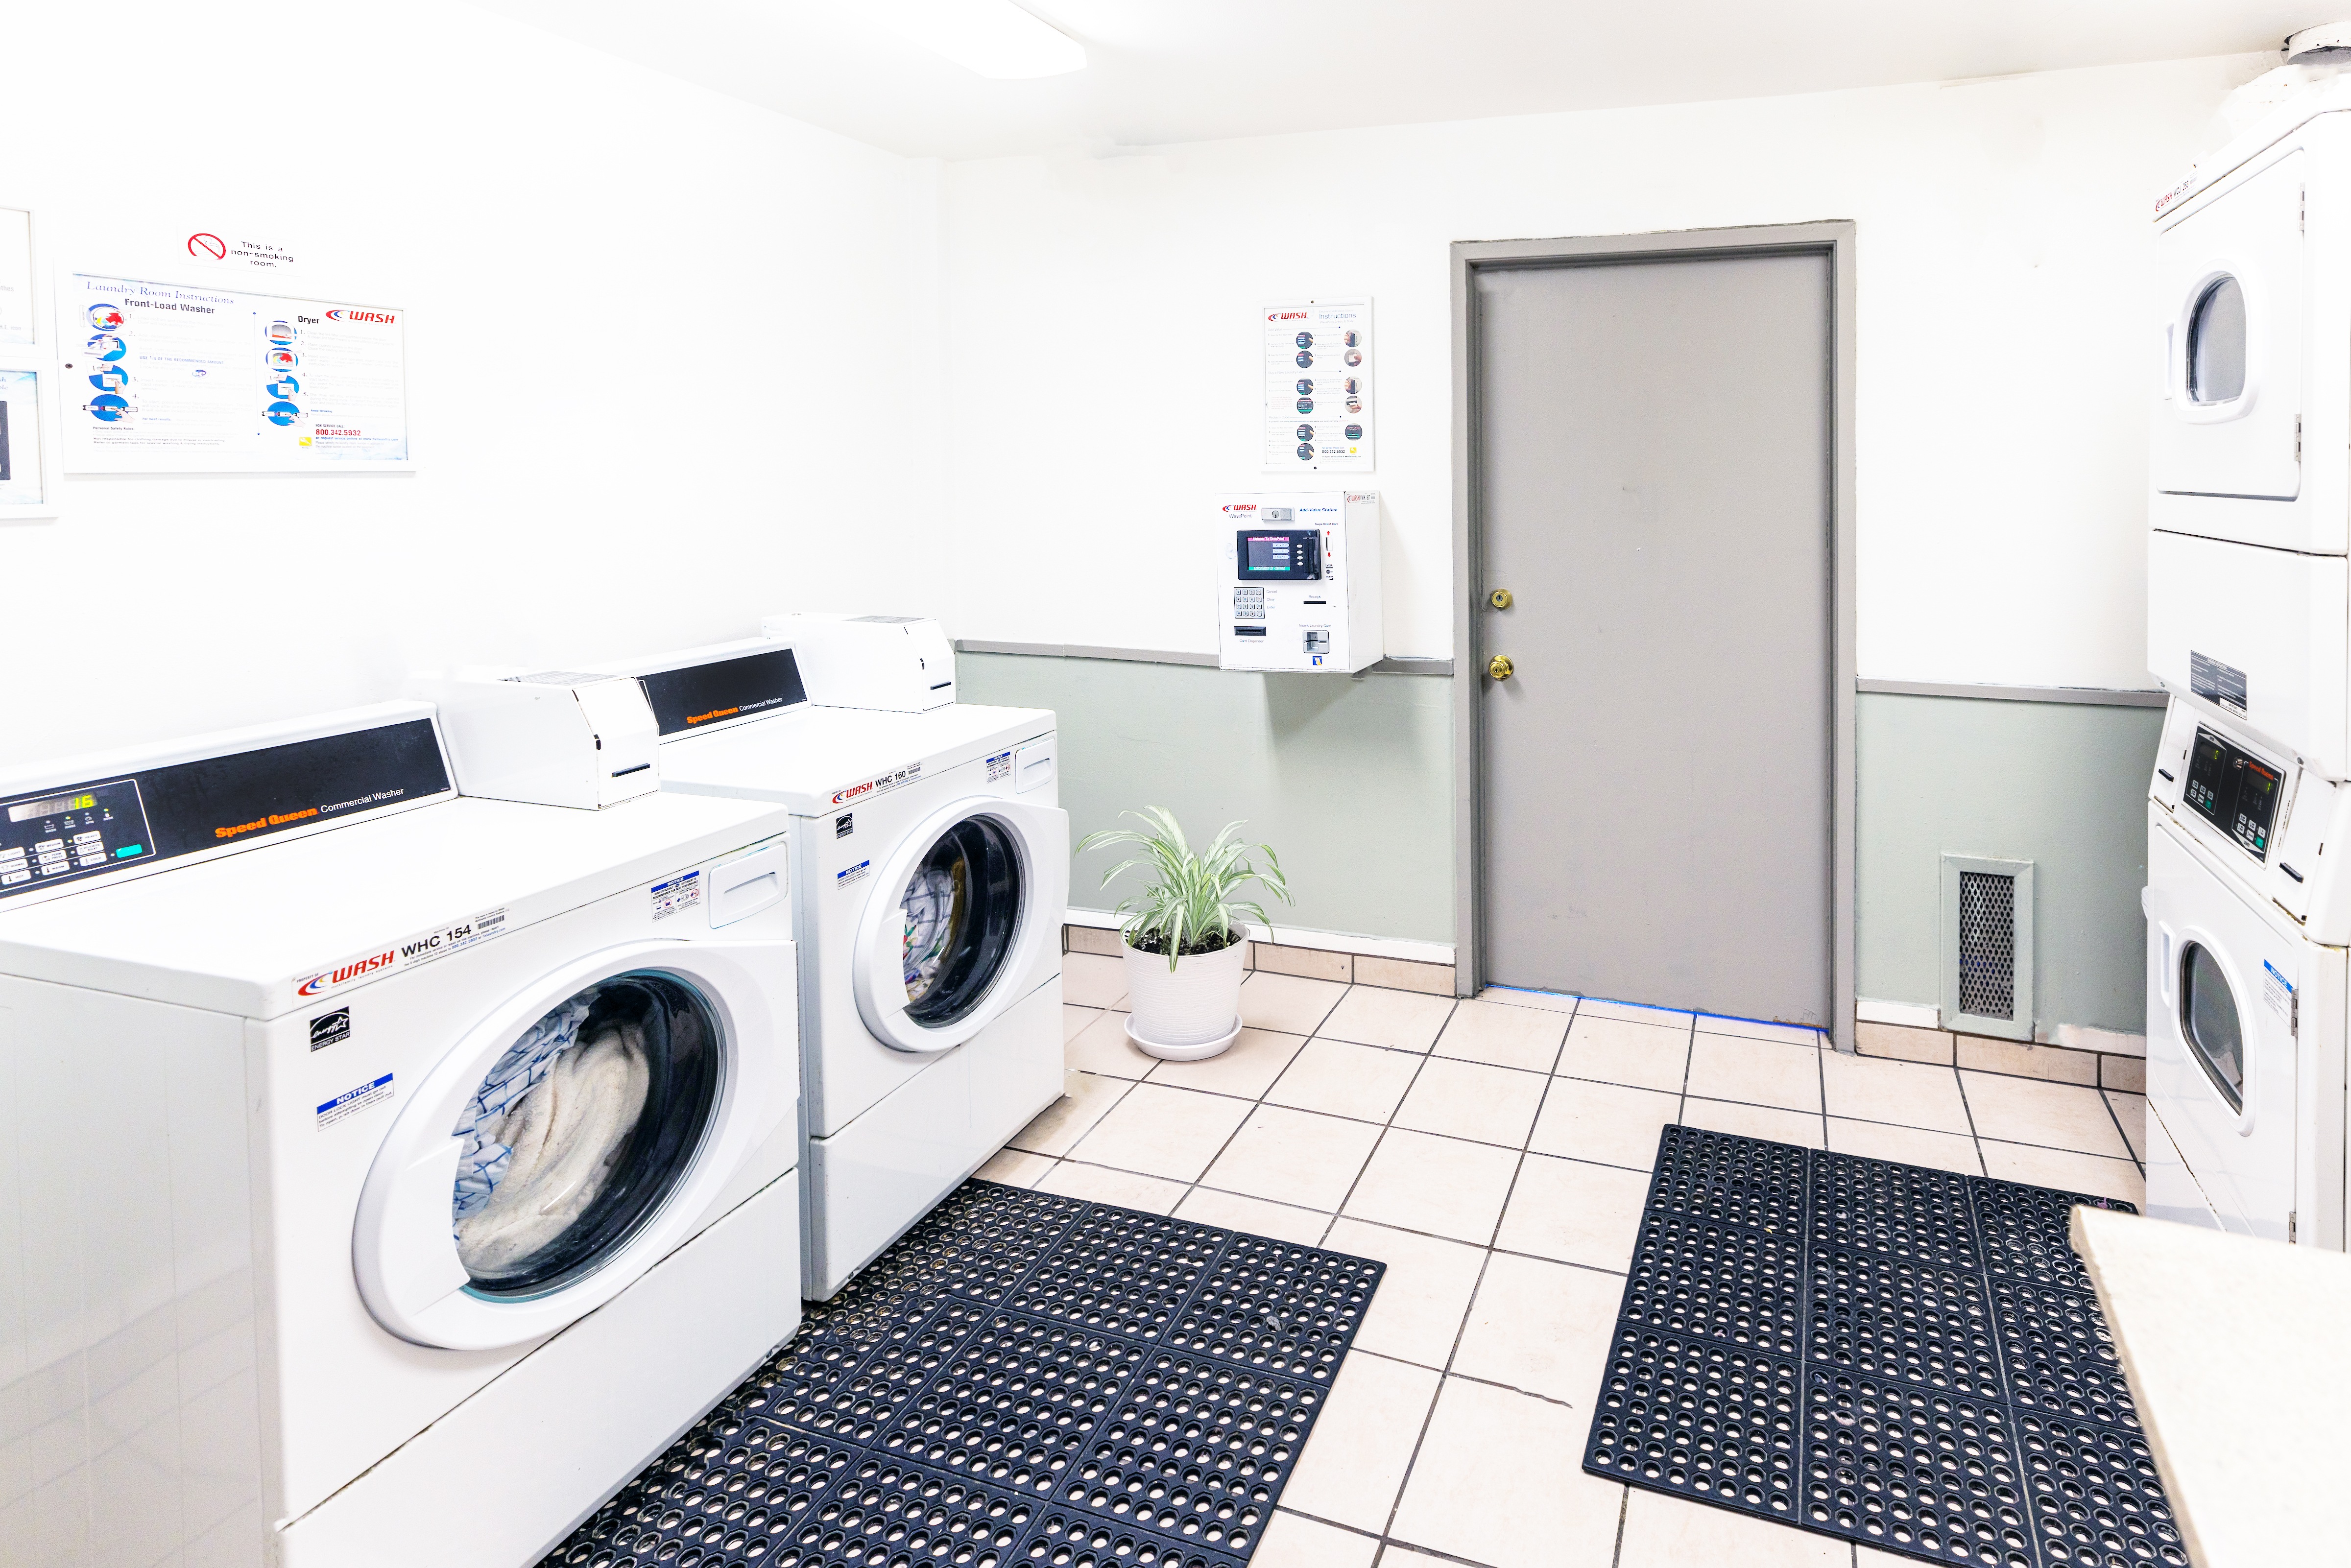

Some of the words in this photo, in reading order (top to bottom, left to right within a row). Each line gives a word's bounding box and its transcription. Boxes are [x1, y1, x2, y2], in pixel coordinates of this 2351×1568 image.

[2161, 191, 2173, 206] WASH
[241, 241, 261, 249] This
[231, 250, 293, 262] non-smoking
[87, 281, 135, 295] Laundry
[140, 287, 170, 297] Room
[175, 290, 234, 304] Instructions
[125, 298, 177, 310] Front-Load
[180, 304, 215, 314] Washer
[298, 315, 320, 324] Dryer
[349, 310, 395, 324] WASH
[686, 712, 713, 724] Speed
[713, 707, 739, 717] Queen
[739, 700, 766, 712] Commercial
[766, 697, 783, 706] Washer
[875, 775, 892, 787] WHC
[894, 770, 906, 780] 160
[2249, 761, 2261, 773] Speed
[2260, 767, 2274, 781] Queen
[846, 782, 873, 798] WASH
[75, 795, 93, 809] 16
[215, 817, 267, 838] Speed
[268, 808, 318, 825] Queen
[320, 795, 372, 813] Commercial
[372, 787, 404, 801] Washer
[845, 863, 862, 875] NOTICE
[667, 877, 684, 886] NOTICE
[401, 935, 440, 957] WHC
[446, 924, 471, 941] 154
[332, 950, 394, 983] WASH
[331, 978, 356, 989] multifamily
[2271, 966, 2288, 988] NOTICE
[312, 1038, 334, 1051] ENERGY
[335, 1032, 350, 1042] STAR
[336, 1082, 375, 1105] NOTICE
[319, 1110, 333, 1119] DOOR
[347, 1097, 361, 1106] LIGHT
[319, 1115, 333, 1123] before
[334, 1104, 357, 1117] attempting
